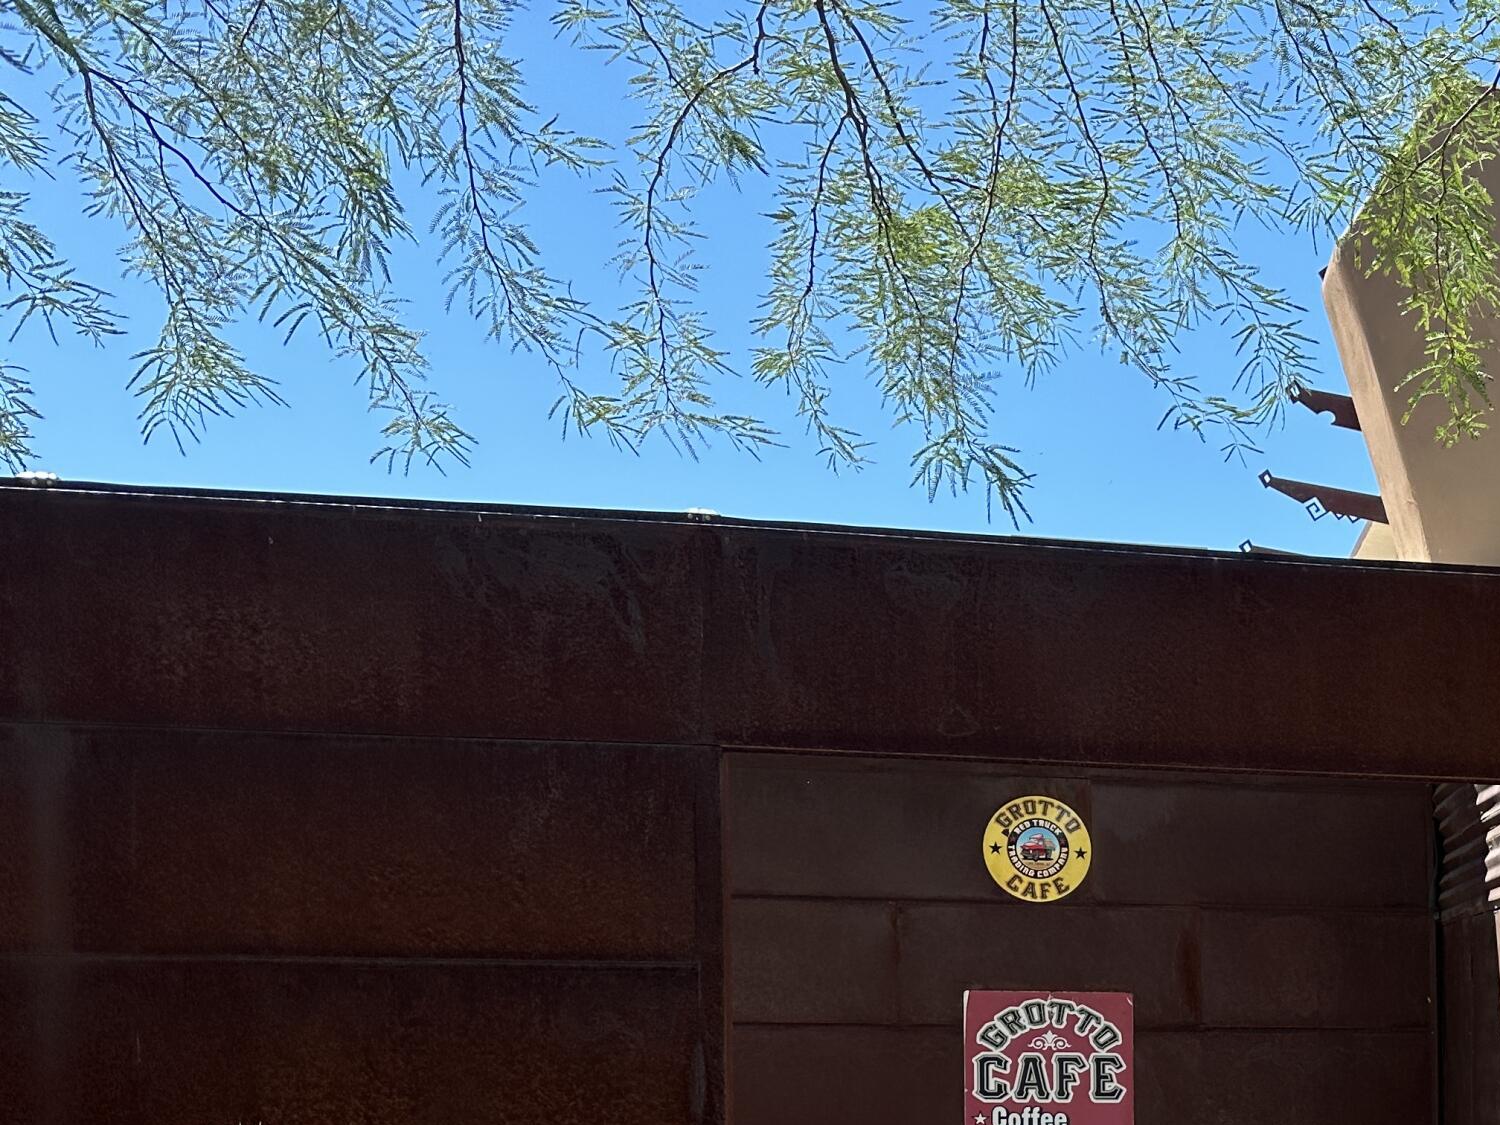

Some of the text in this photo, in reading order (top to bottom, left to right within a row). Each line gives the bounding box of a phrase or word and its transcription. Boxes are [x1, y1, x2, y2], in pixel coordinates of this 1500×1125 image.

[995, 799, 1081, 834] GROTTO
[1014, 819, 1062, 835] RED TRUCK
[1008, 845, 1068, 878] TRADING COMPANY
[1006, 875, 1070, 899] CAFE
[976, 999, 1122, 1051] GROTTO
[972, 1052, 1127, 1103] CAFE
